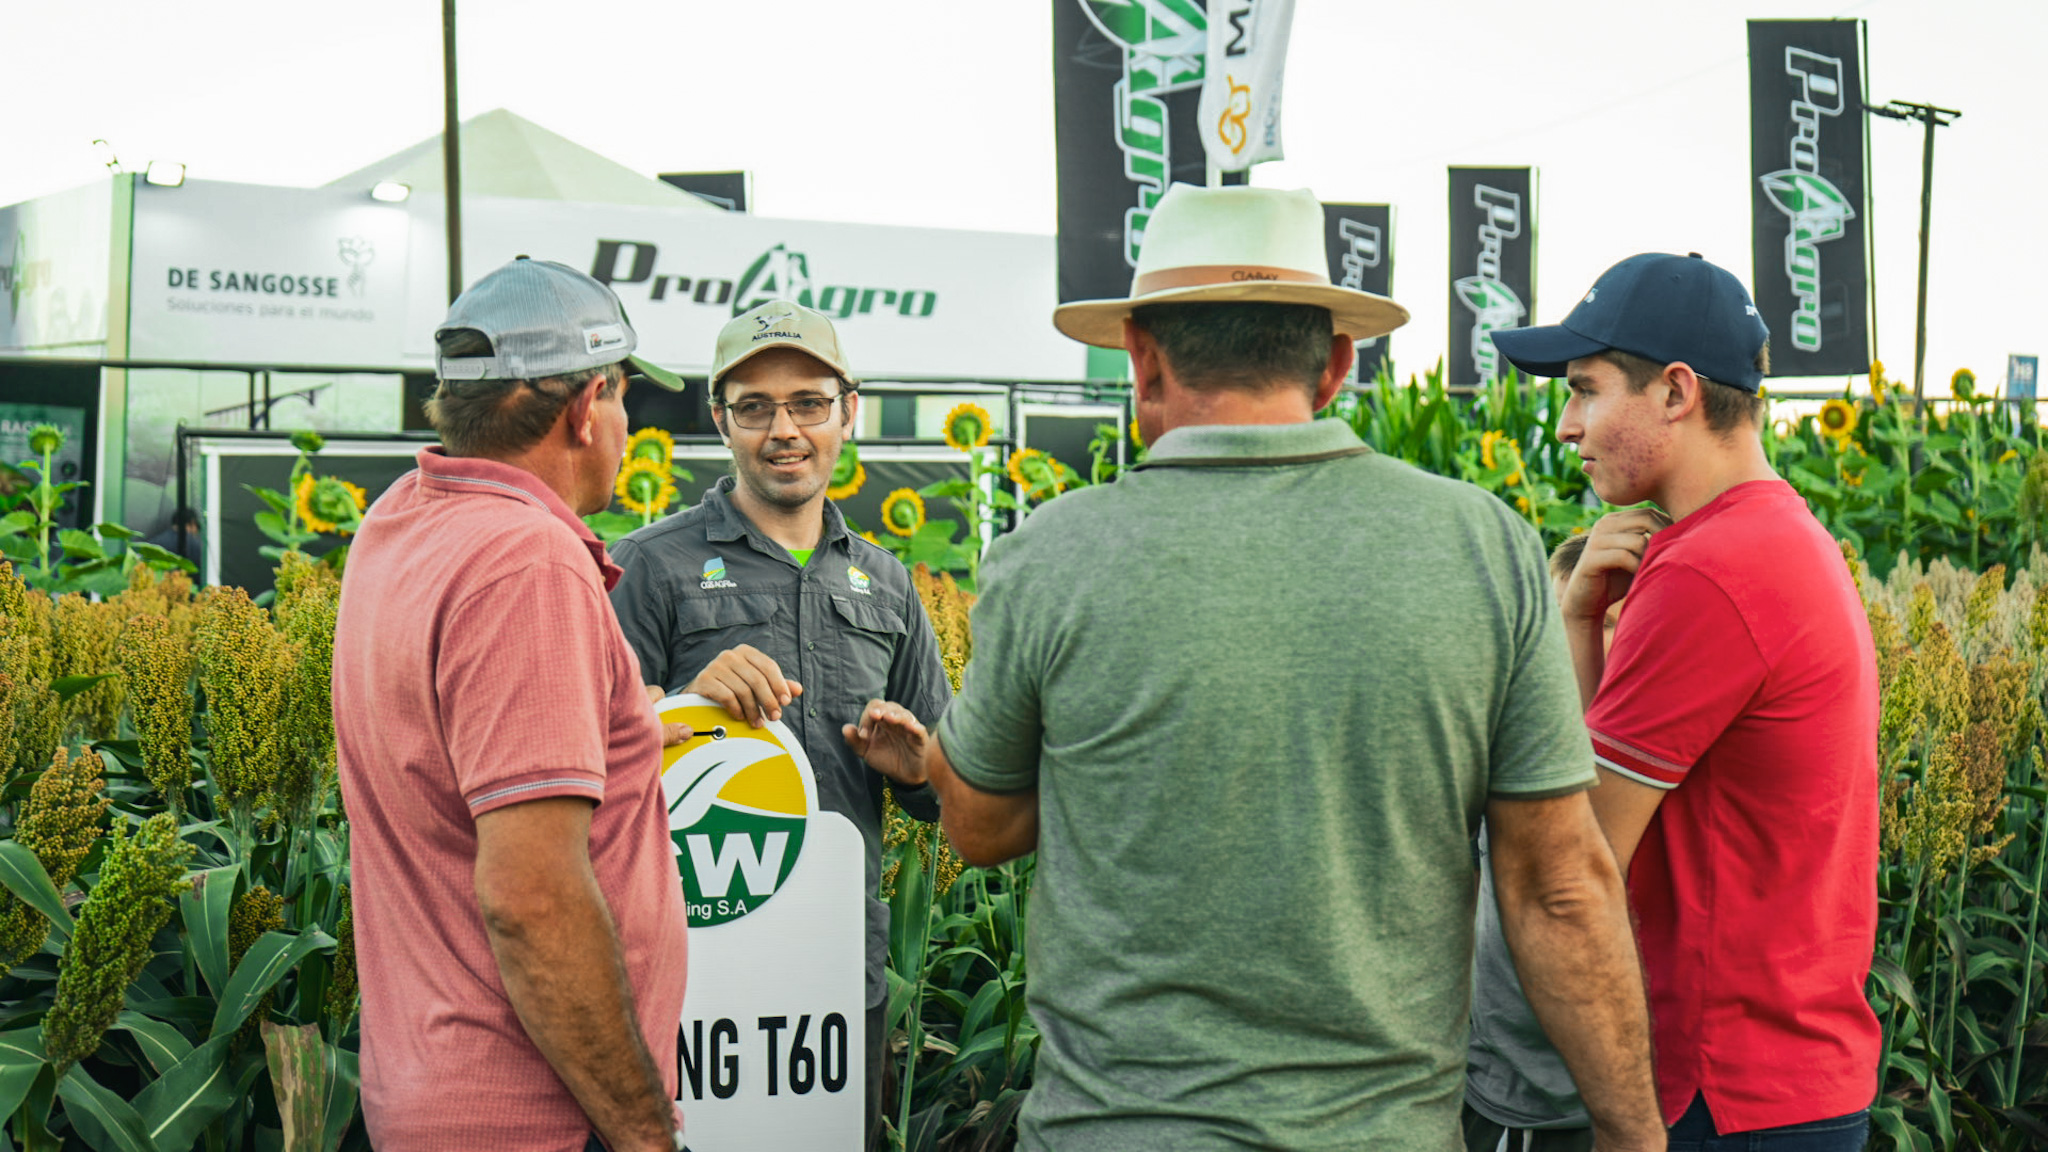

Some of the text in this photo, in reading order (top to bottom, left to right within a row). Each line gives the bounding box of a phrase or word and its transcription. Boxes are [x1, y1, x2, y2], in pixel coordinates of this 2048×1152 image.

[1759, 46, 1856, 352] ProAgro
[168, 267, 338, 297] DE SANGOSSE
[589, 238, 937, 319] ProAgro
[167, 299, 374, 322] Soluciones para el mundo
[752, 331, 802, 341] AUSTRALIA
[757, 1011, 848, 1095] T60
